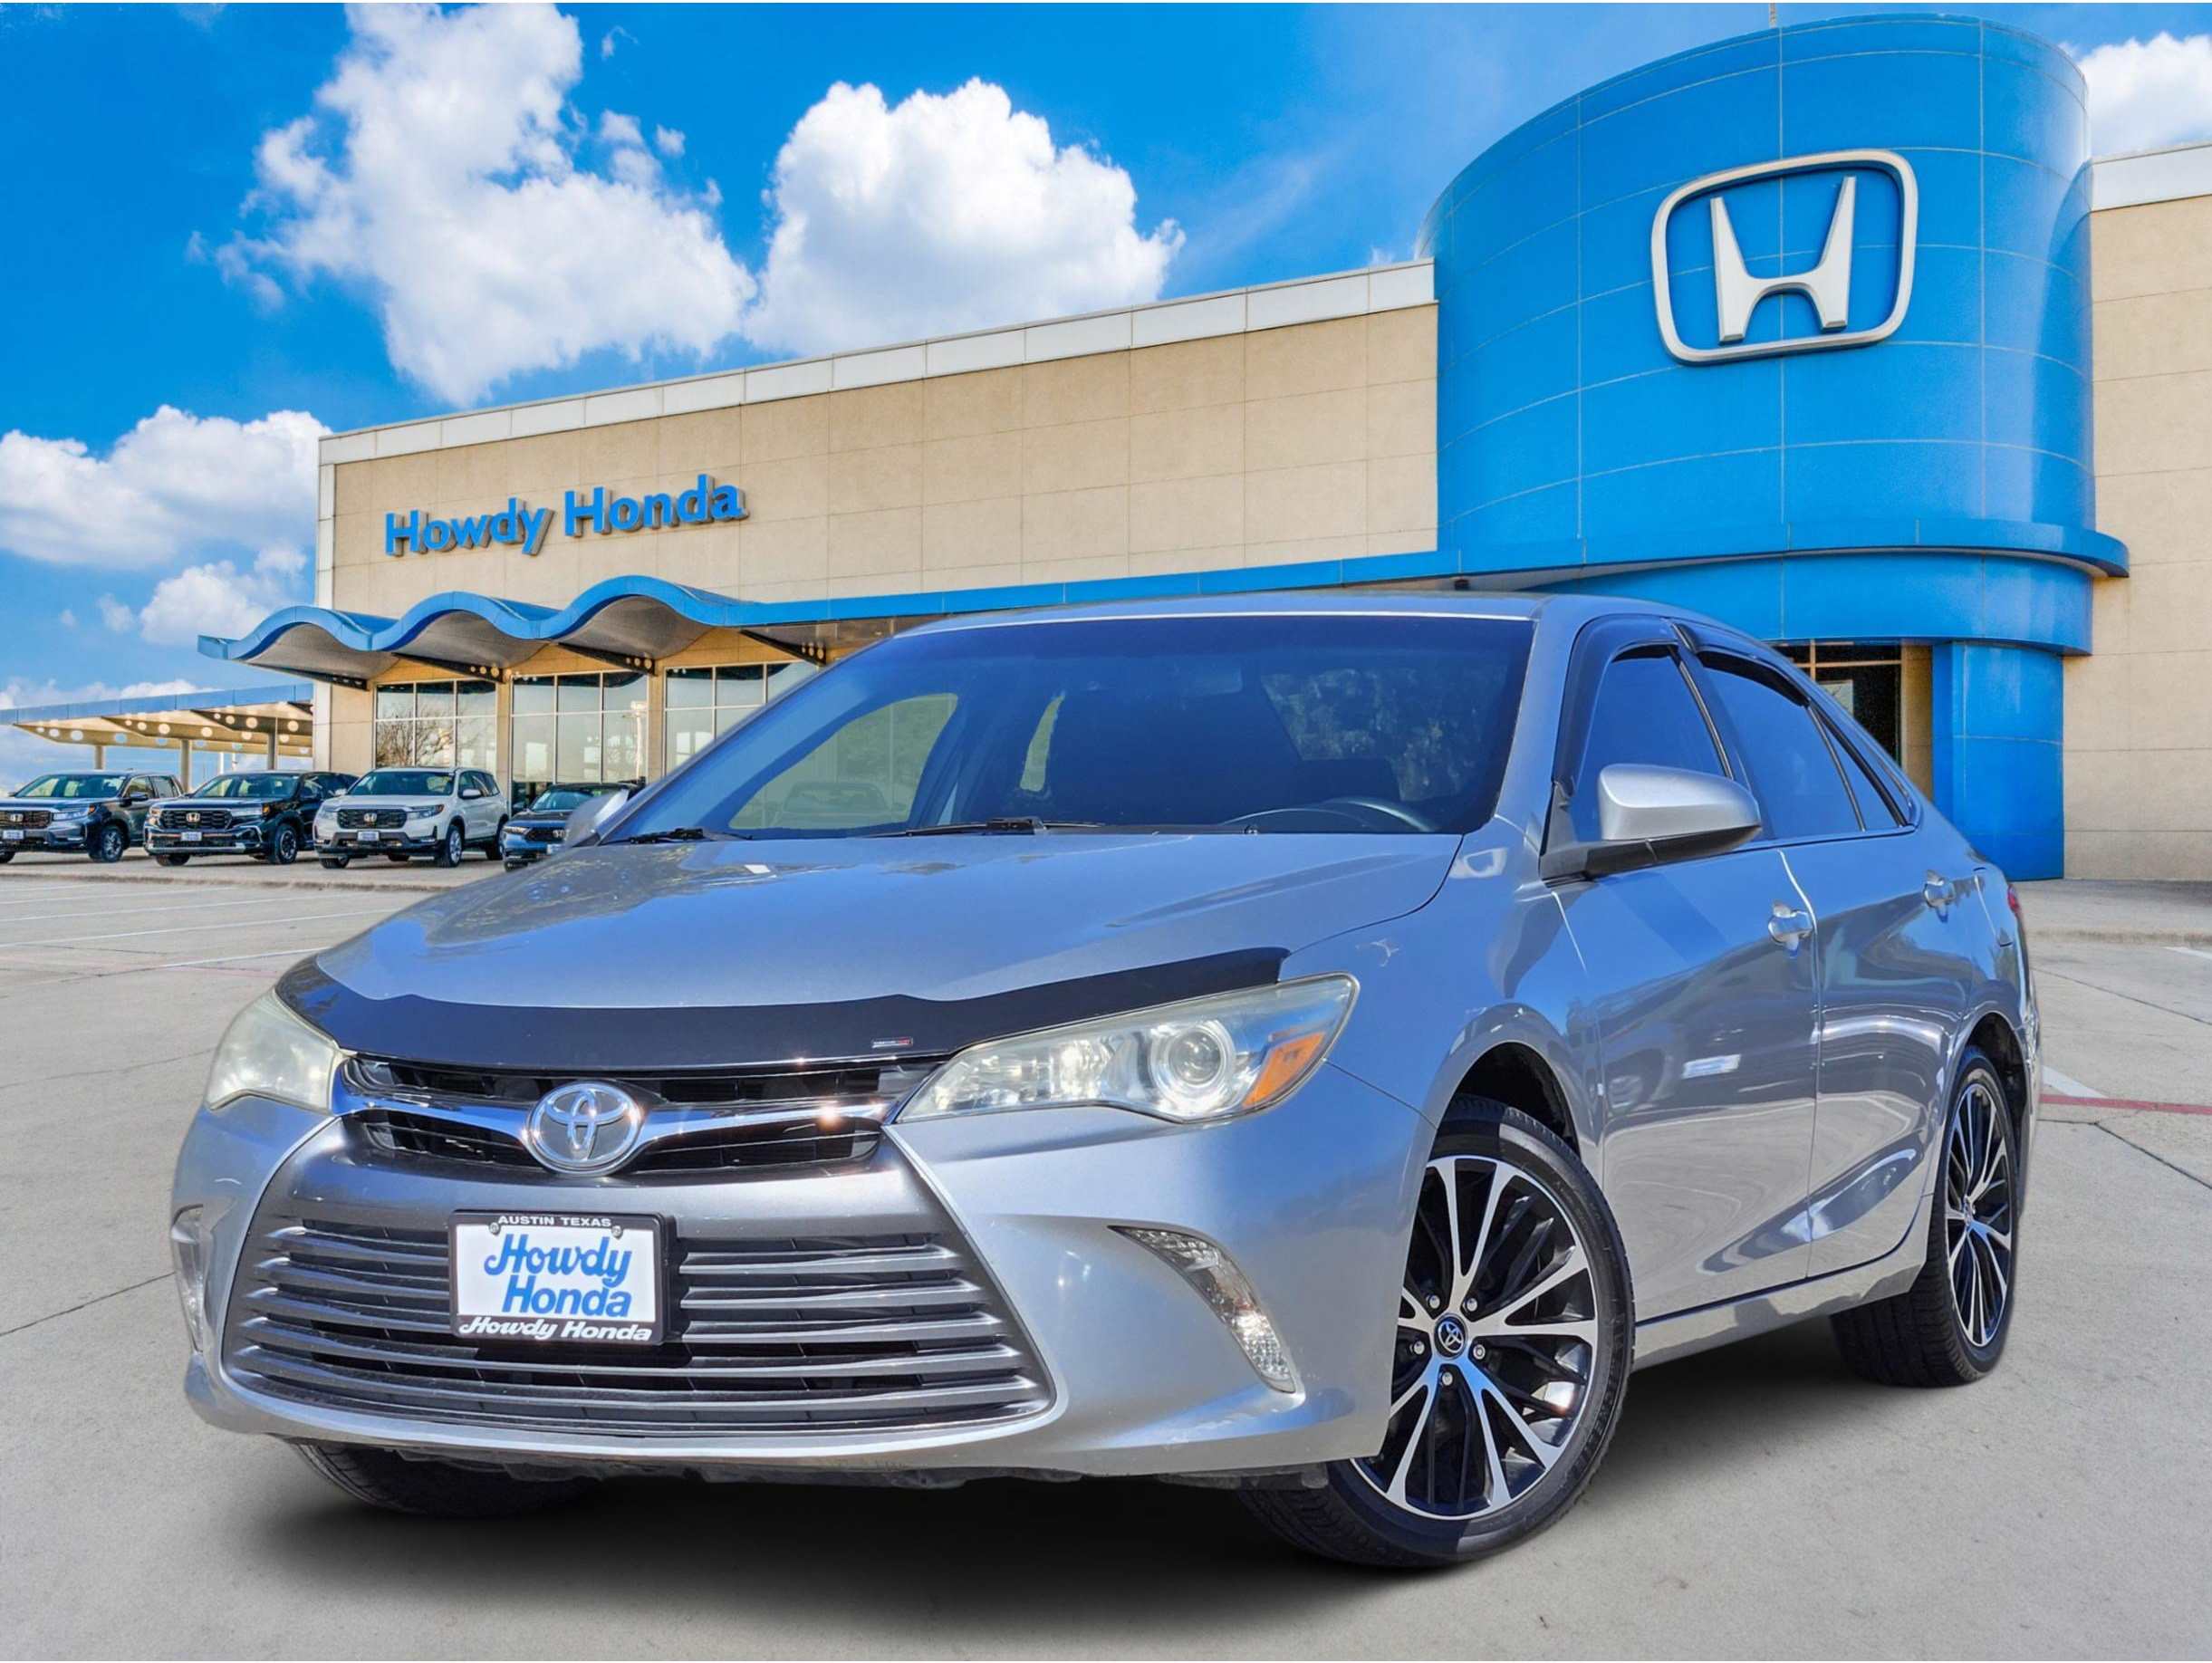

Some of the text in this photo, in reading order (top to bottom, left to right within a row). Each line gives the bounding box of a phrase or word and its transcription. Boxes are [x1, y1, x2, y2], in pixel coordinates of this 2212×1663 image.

[385, 474, 749, 556] Howdy Honda
[498, 1216, 611, 1227] AUSTIN TEXAS
[484, 1234, 632, 1288] Howdy
[502, 1274, 632, 1318] Honda
[458, 1316, 652, 1341] Howdy Honda
